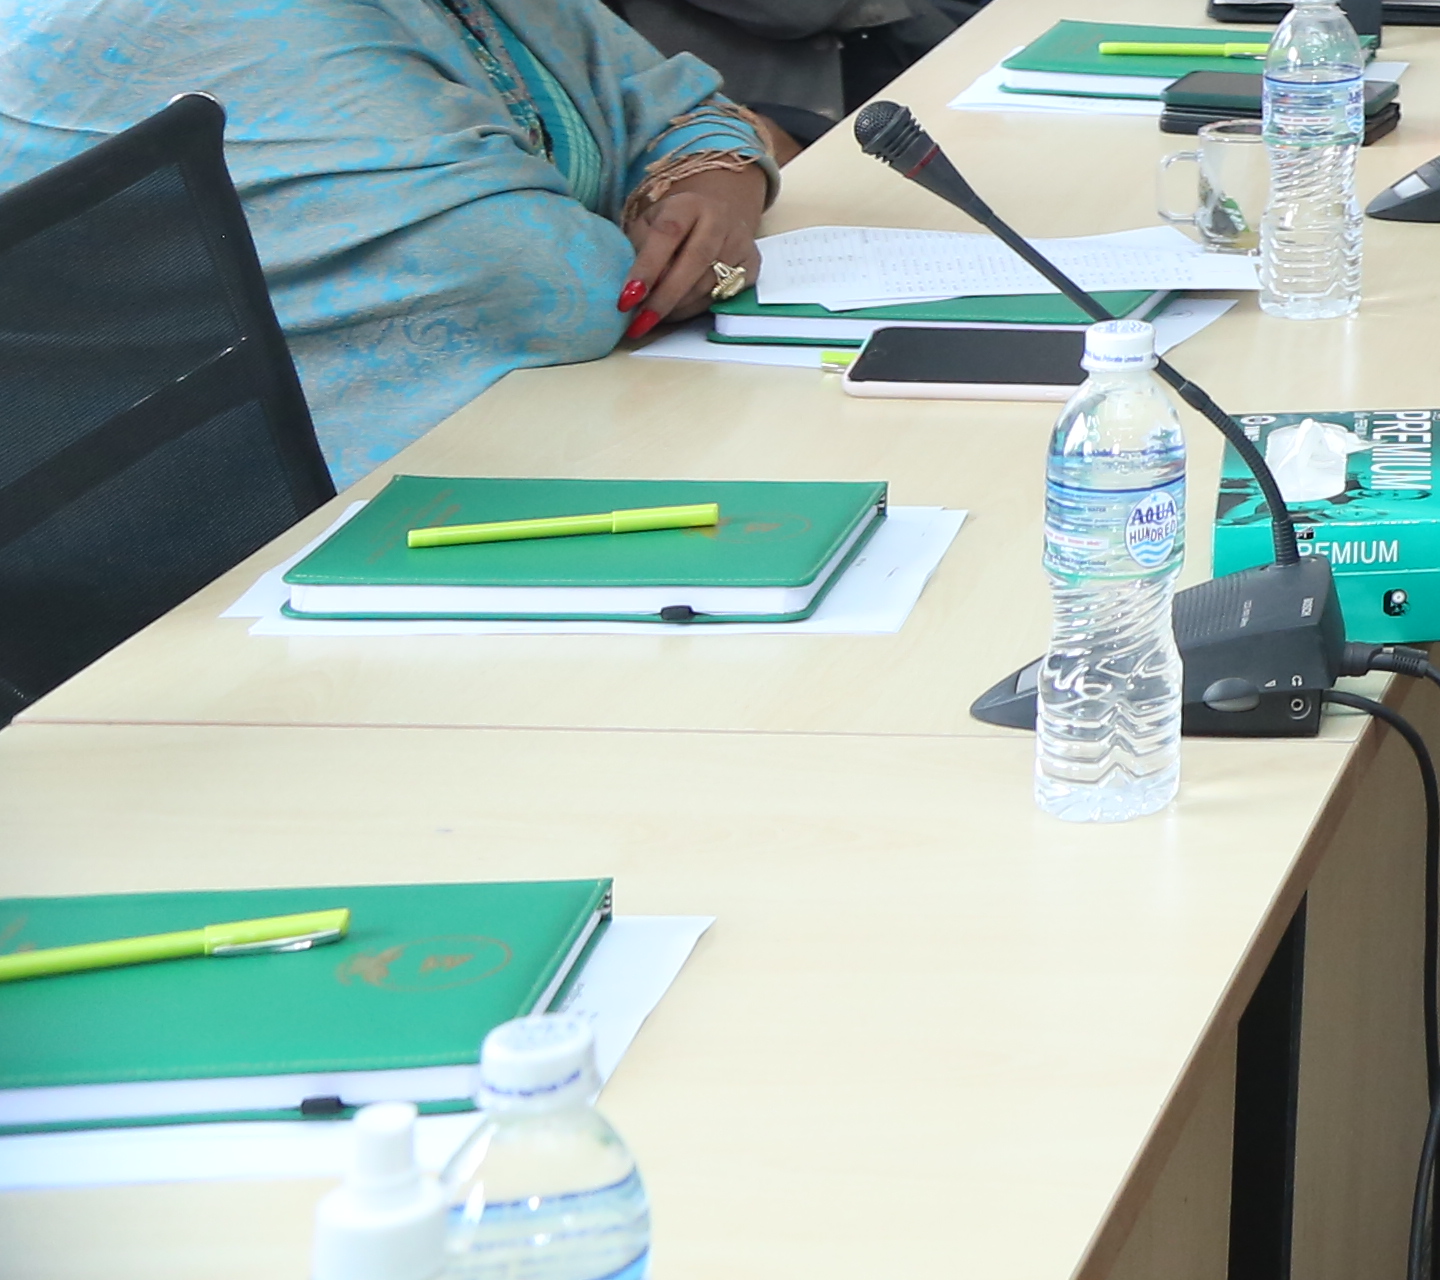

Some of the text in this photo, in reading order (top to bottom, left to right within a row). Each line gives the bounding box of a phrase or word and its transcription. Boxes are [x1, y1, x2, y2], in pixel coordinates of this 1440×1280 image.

[1371, 411, 1432, 490] PREMIUM
[1131, 500, 1175, 526] AQUA
[1129, 522, 1177, 545] HUNDRED
